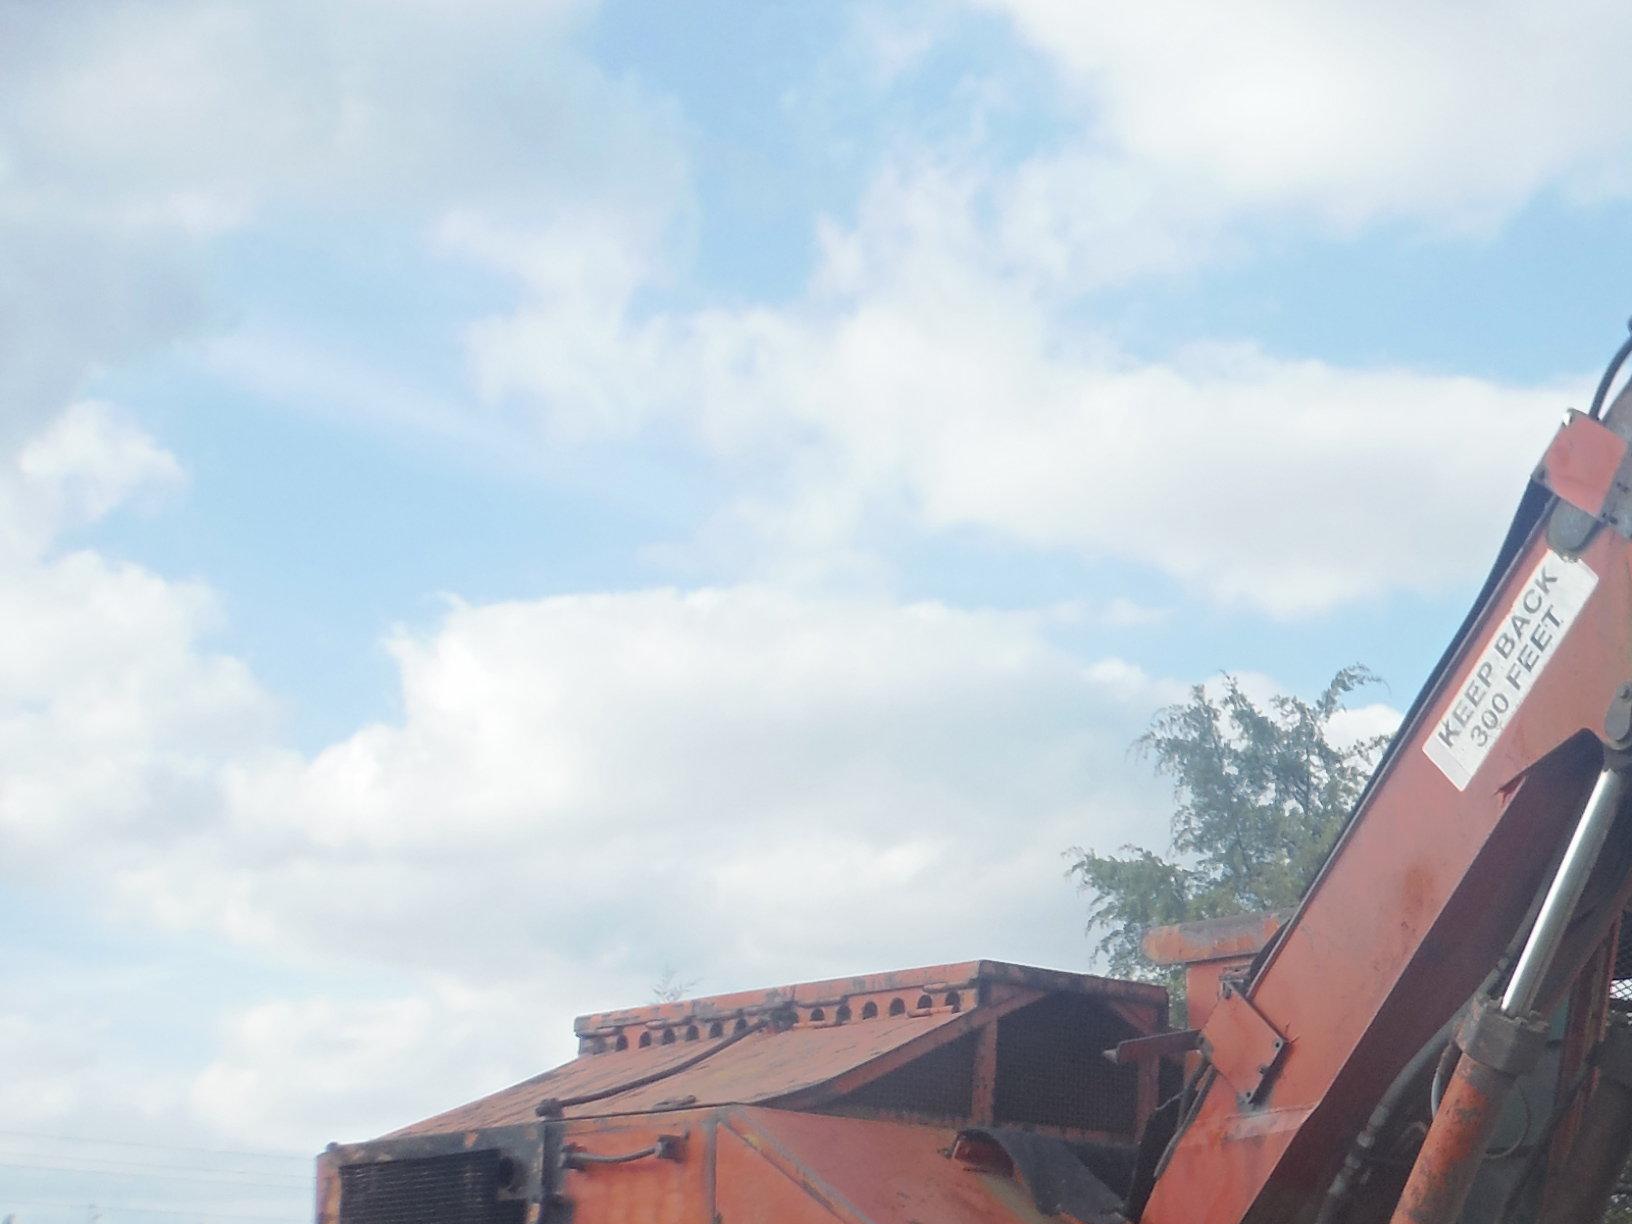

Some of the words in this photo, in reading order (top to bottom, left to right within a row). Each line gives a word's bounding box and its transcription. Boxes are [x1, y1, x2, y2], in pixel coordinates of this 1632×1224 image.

[1438, 662, 1494, 747] KEEP
[1494, 566, 1557, 659] BACK
[1470, 692, 1509, 748] 300
[1506, 604, 1563, 690] FEET
